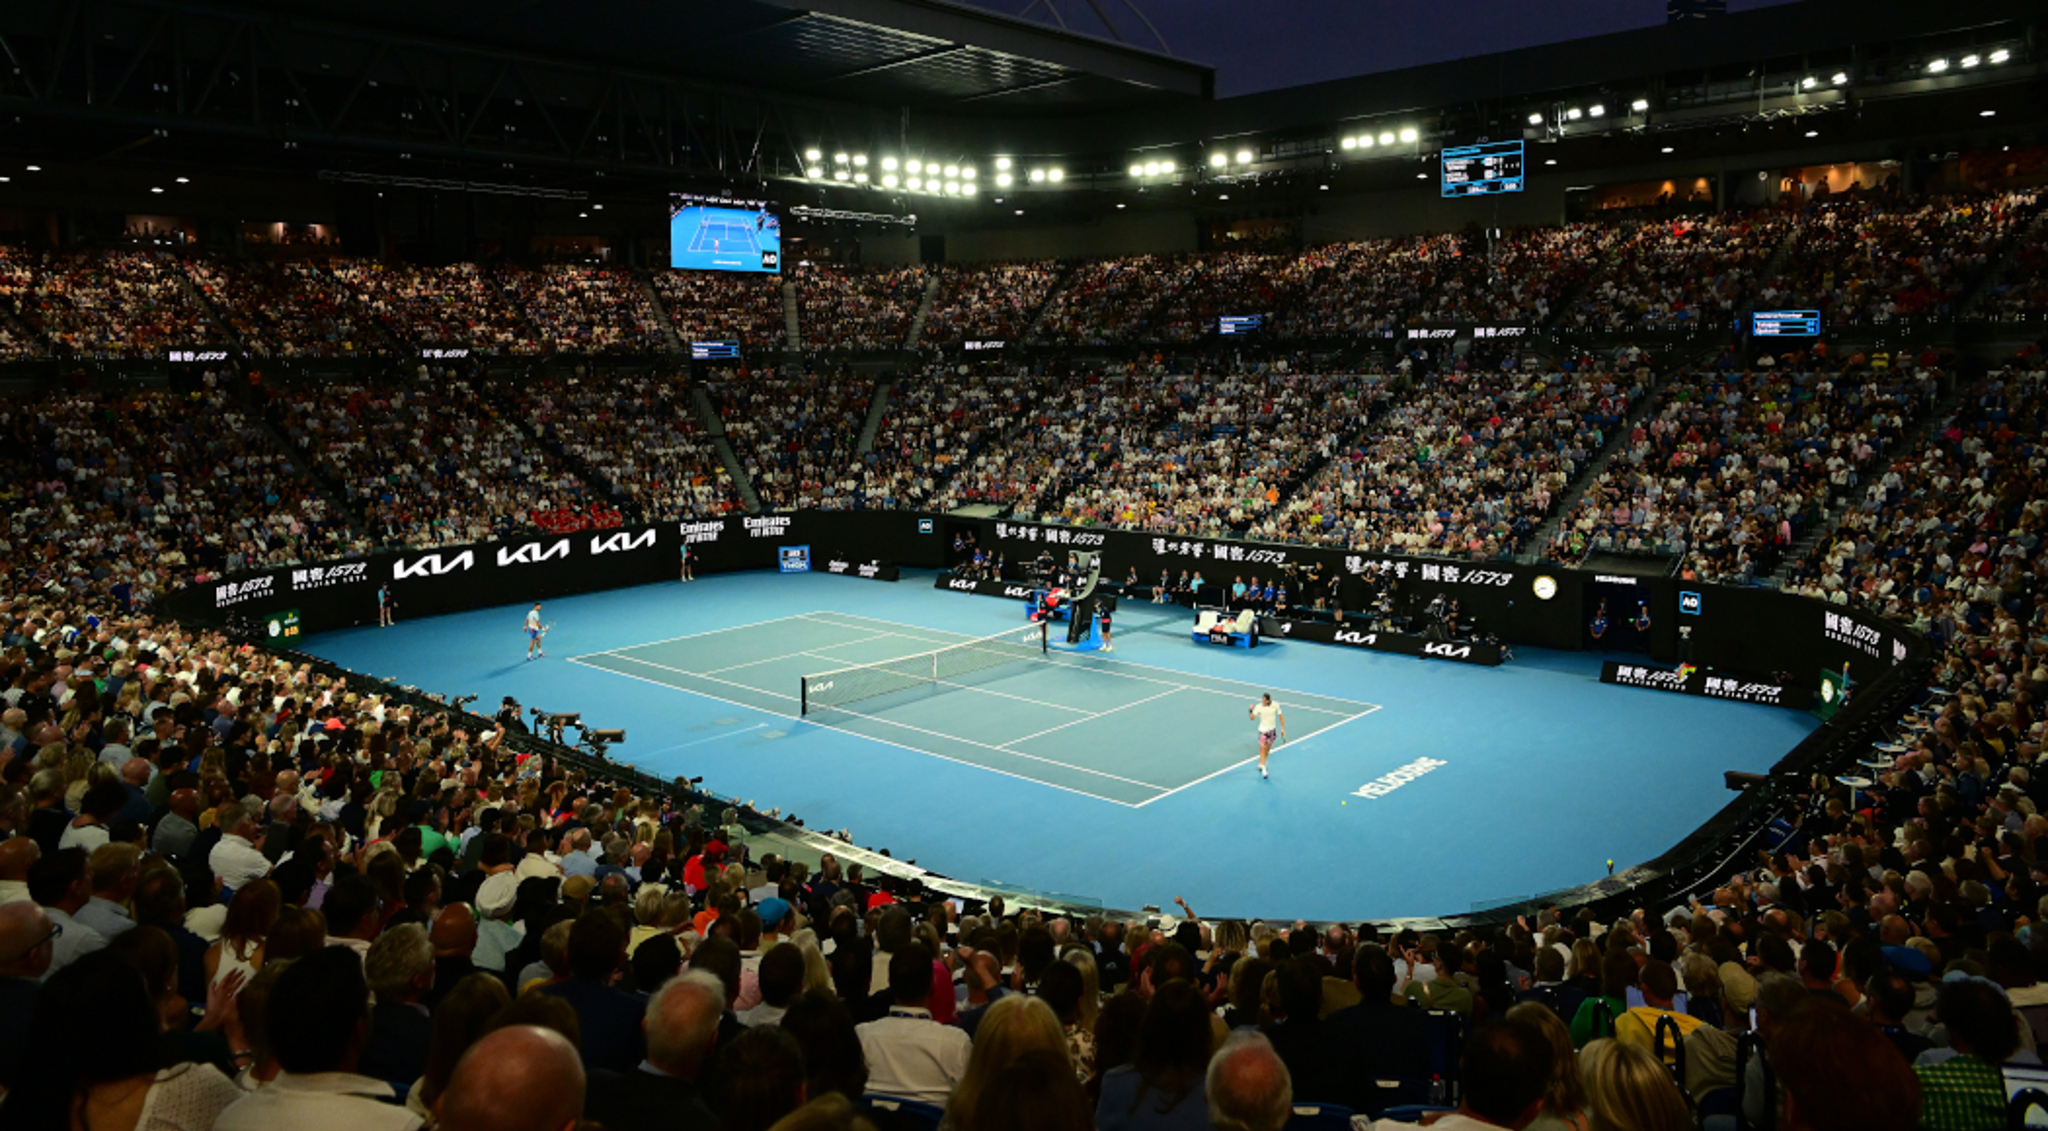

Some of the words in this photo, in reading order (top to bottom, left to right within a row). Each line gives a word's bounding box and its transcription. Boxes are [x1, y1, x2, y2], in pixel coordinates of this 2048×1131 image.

[680, 521, 725, 535] Emirates
[743, 516, 791, 529] Emirates
[591, 529, 656, 554] KIA
[497, 539, 570, 566] KIA
[393, 550, 474, 580] KIA
[950, 579, 978, 590] KIA
[1683, 597, 1698, 608] AO
[1023, 632, 1043, 643] KIA
[1334, 630, 1377, 645] KIA
[1425, 642, 1471, 658] KIA
[809, 681, 834, 694] KIA
[1350, 757, 1448, 799] MELBOURNE
